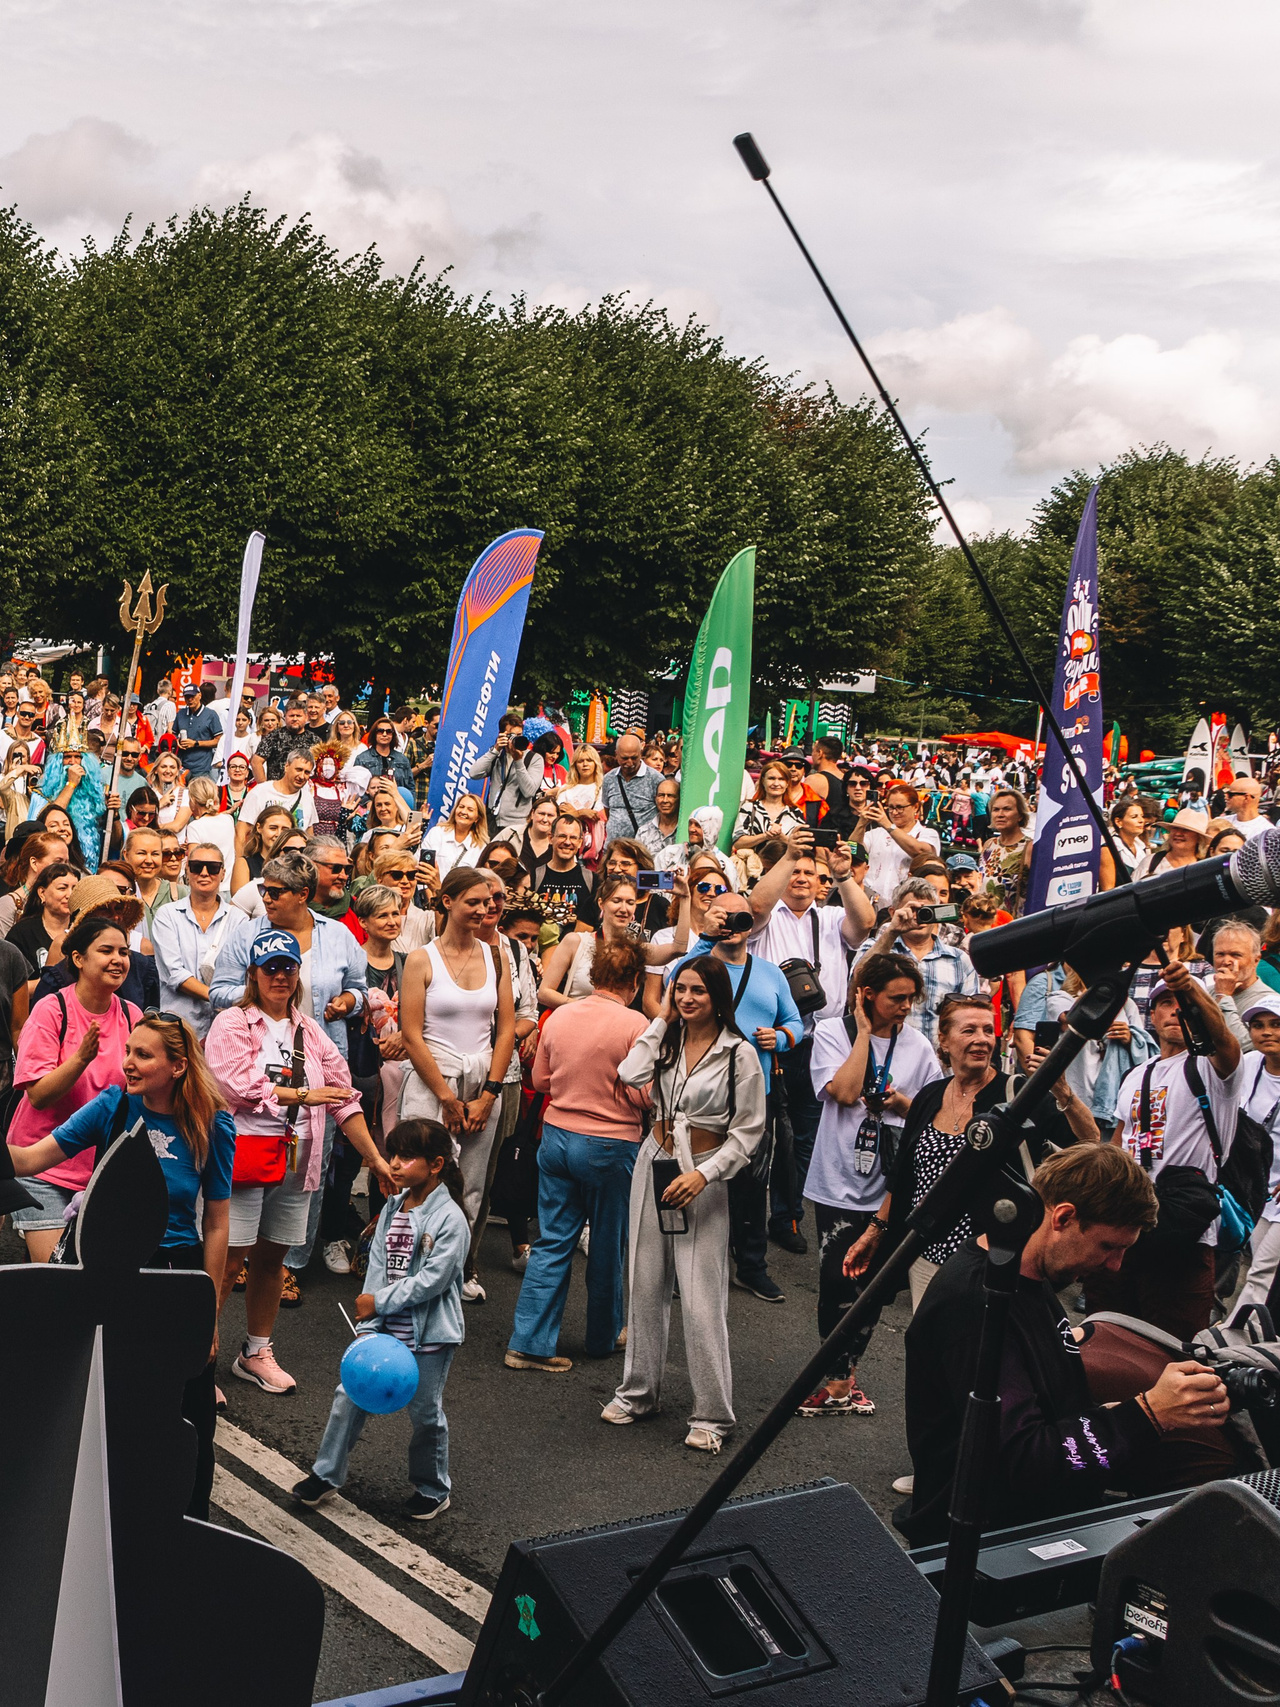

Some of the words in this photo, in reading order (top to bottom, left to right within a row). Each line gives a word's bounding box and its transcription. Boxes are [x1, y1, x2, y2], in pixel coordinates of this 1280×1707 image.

[471, 650, 501, 738] НЕФТИ
[1057, 834, 1089, 848] упер
[864, 1139, 875, 1148] VIP
[972, 1120, 989, 1151] K&M
